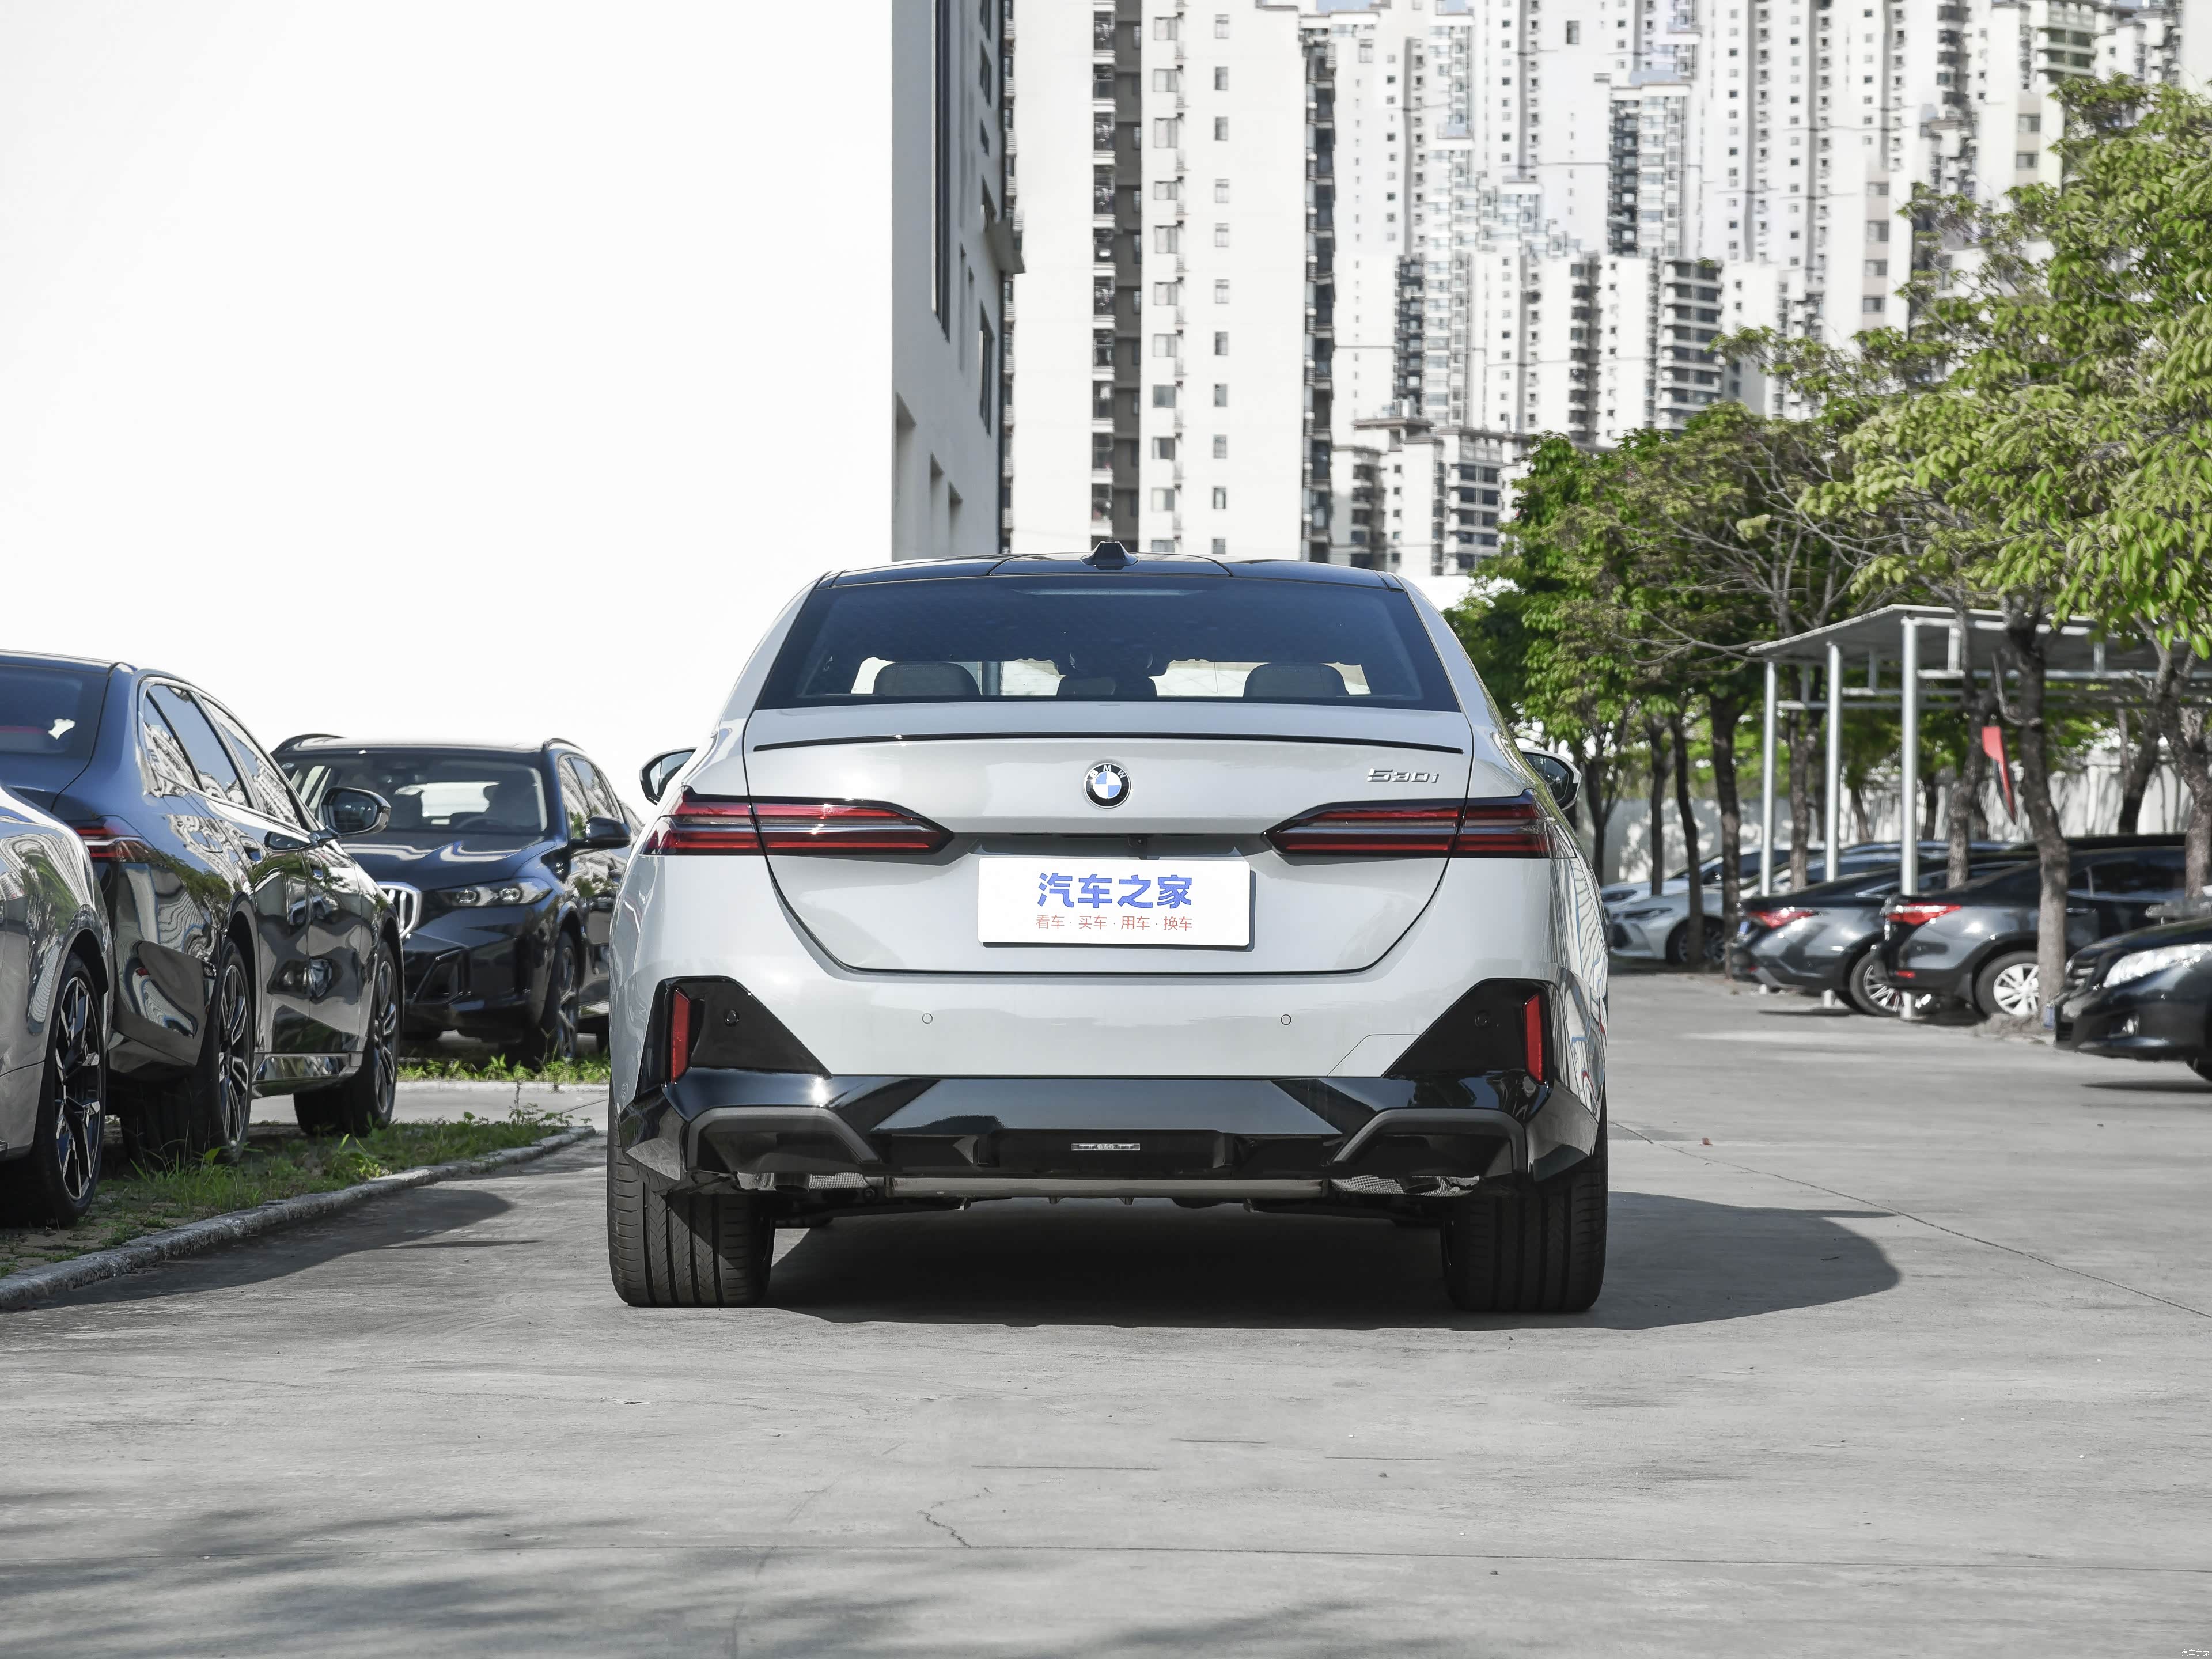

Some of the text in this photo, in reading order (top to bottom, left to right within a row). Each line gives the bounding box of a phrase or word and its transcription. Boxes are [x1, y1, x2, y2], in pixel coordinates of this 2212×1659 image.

[1089, 764, 1126, 779] BMW
[1367, 768, 1439, 783] 530i
[1037, 872, 1192, 909] 汽车之家
